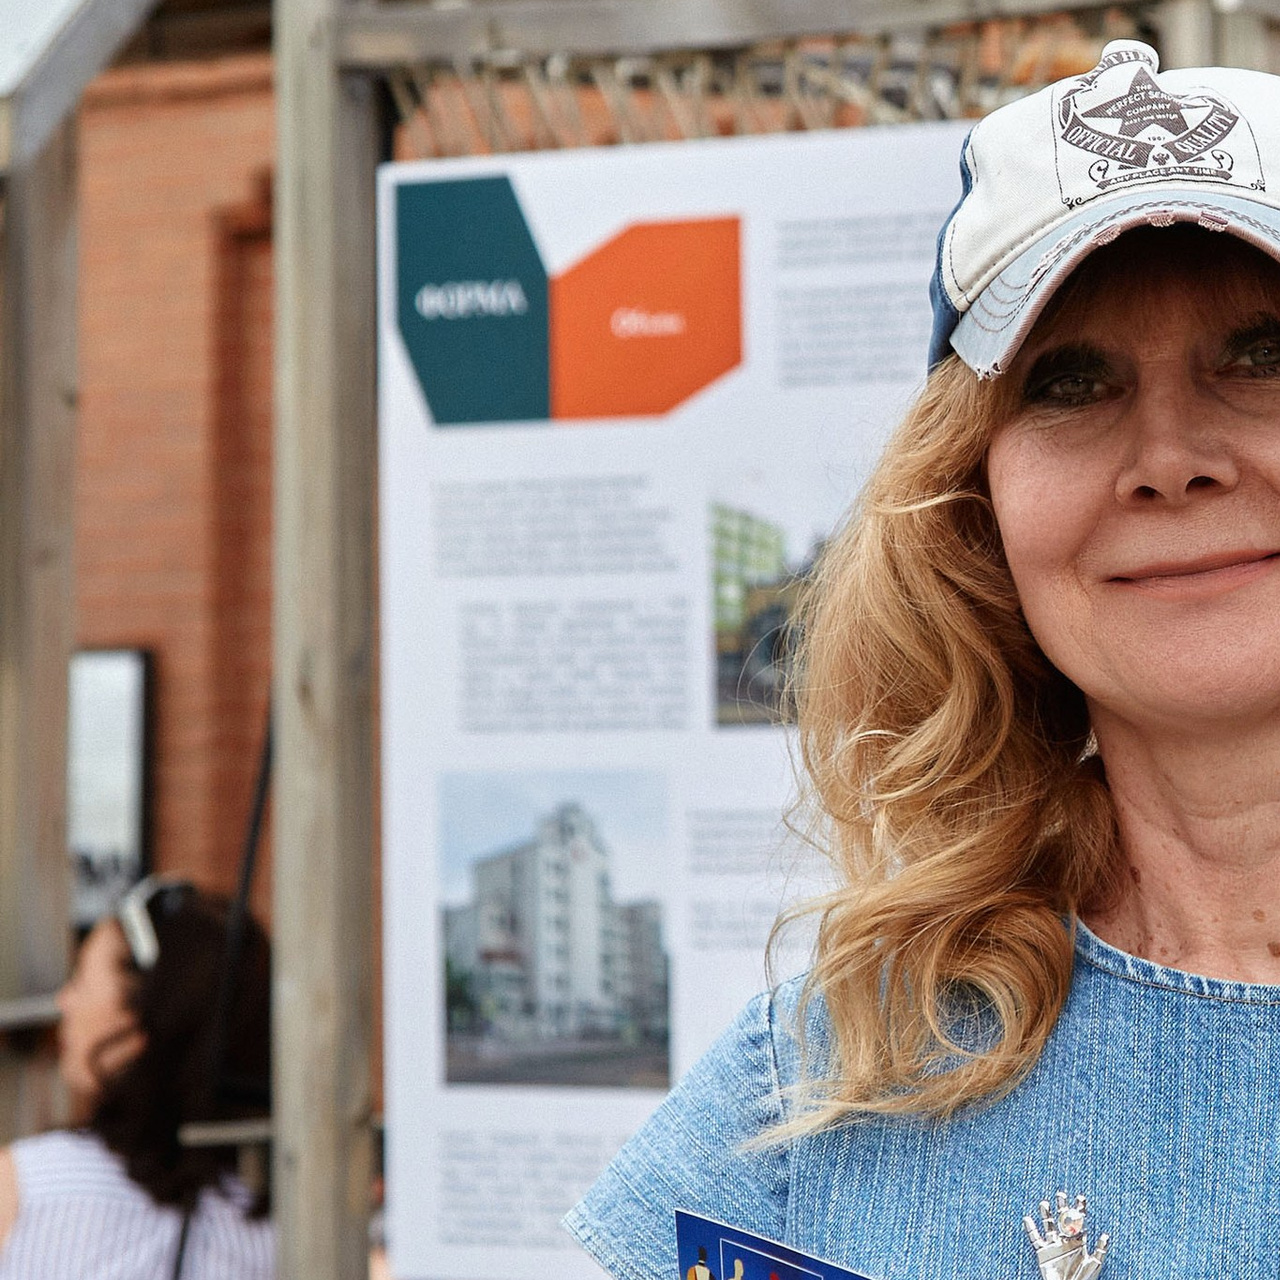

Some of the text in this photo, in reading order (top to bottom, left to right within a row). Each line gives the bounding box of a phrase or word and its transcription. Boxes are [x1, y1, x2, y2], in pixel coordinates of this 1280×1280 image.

[1106, 92, 1146, 116] PERFECT
[1126, 103, 1171, 116] COMPANY
[1066, 126, 1137, 159] OFFICIAL
[1174, 111, 1234, 155] QUALITY
[1110, 175, 1130, 184] ANY
[1168, 166, 1190, 174] ANY
[1193, 167, 1217, 175] TIME
[415, 279, 528, 320] ФОРМА
